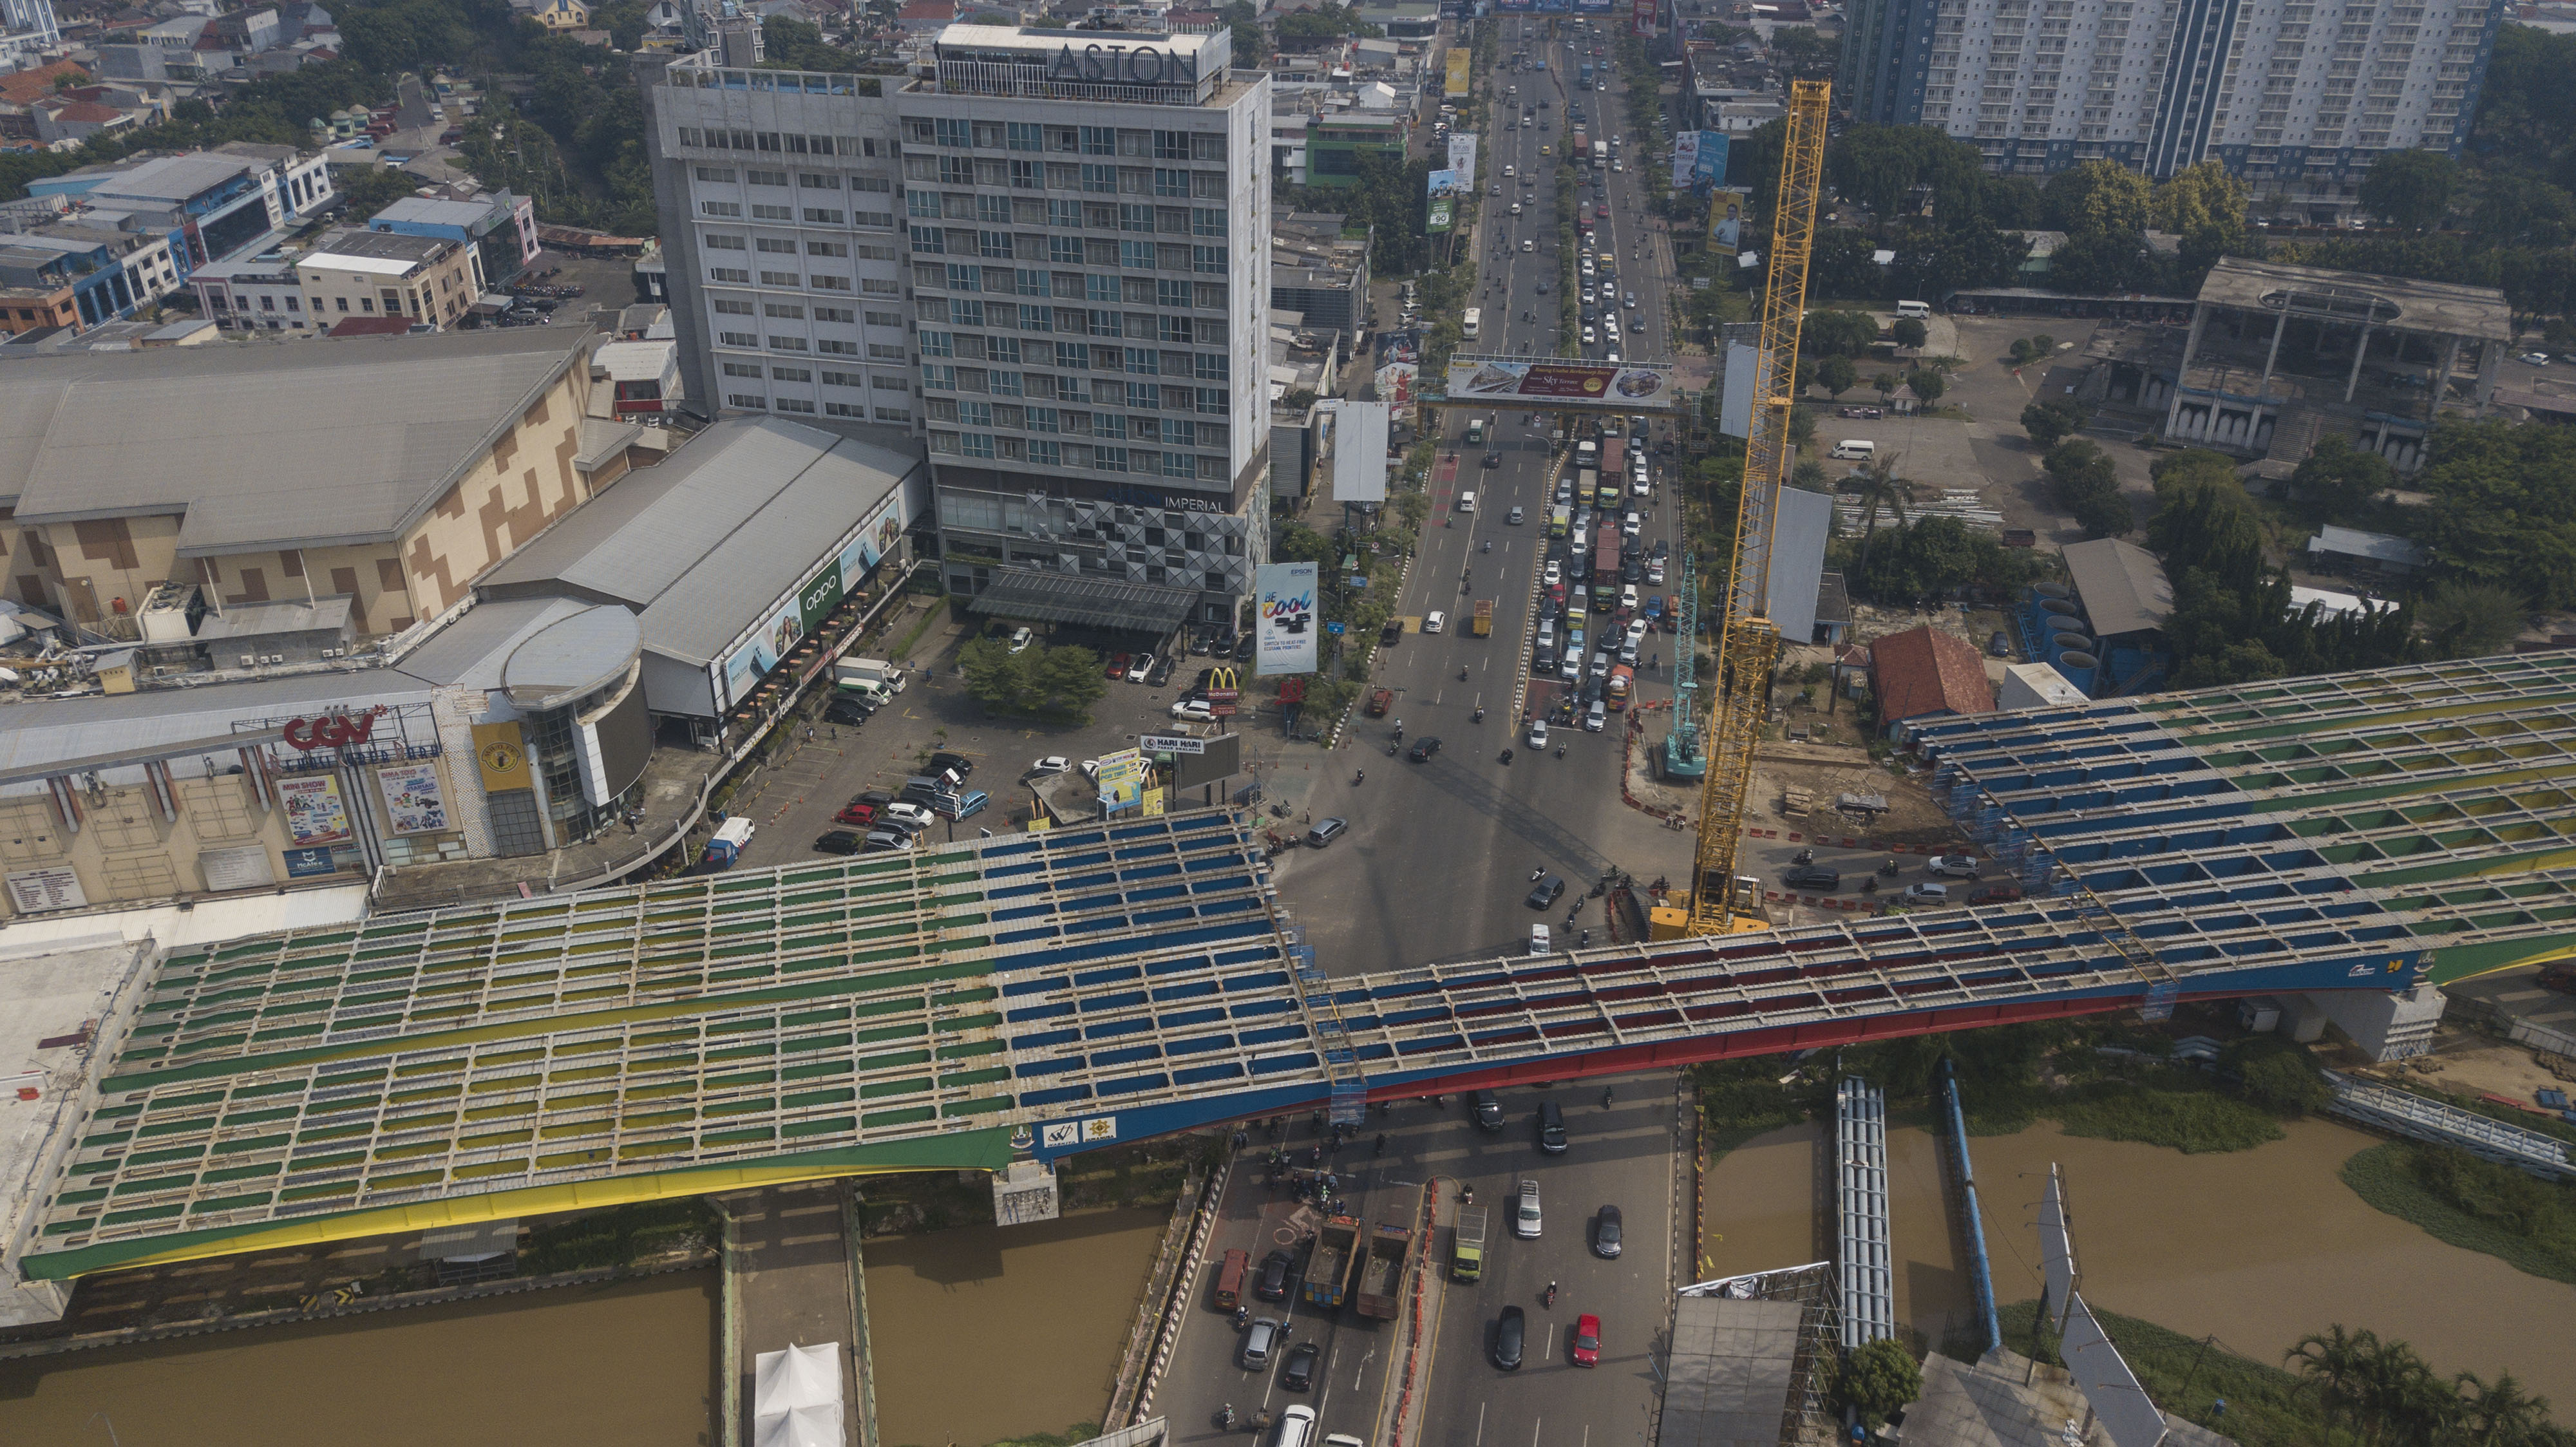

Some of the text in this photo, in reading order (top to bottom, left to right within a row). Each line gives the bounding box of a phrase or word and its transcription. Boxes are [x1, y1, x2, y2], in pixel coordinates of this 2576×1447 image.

[1053, 43, 1197, 84] ASTON
[1542, 375, 1558, 386] Sky
[1165, 497, 1224, 513] IMPERIAL
[806, 575, 837, 611] oppo
[1265, 592, 1276, 602] BE
[284, 713, 374, 750] CGV
[1157, 739, 1200, 748] HARI HARI
[301, 780, 325, 789] SHOW
